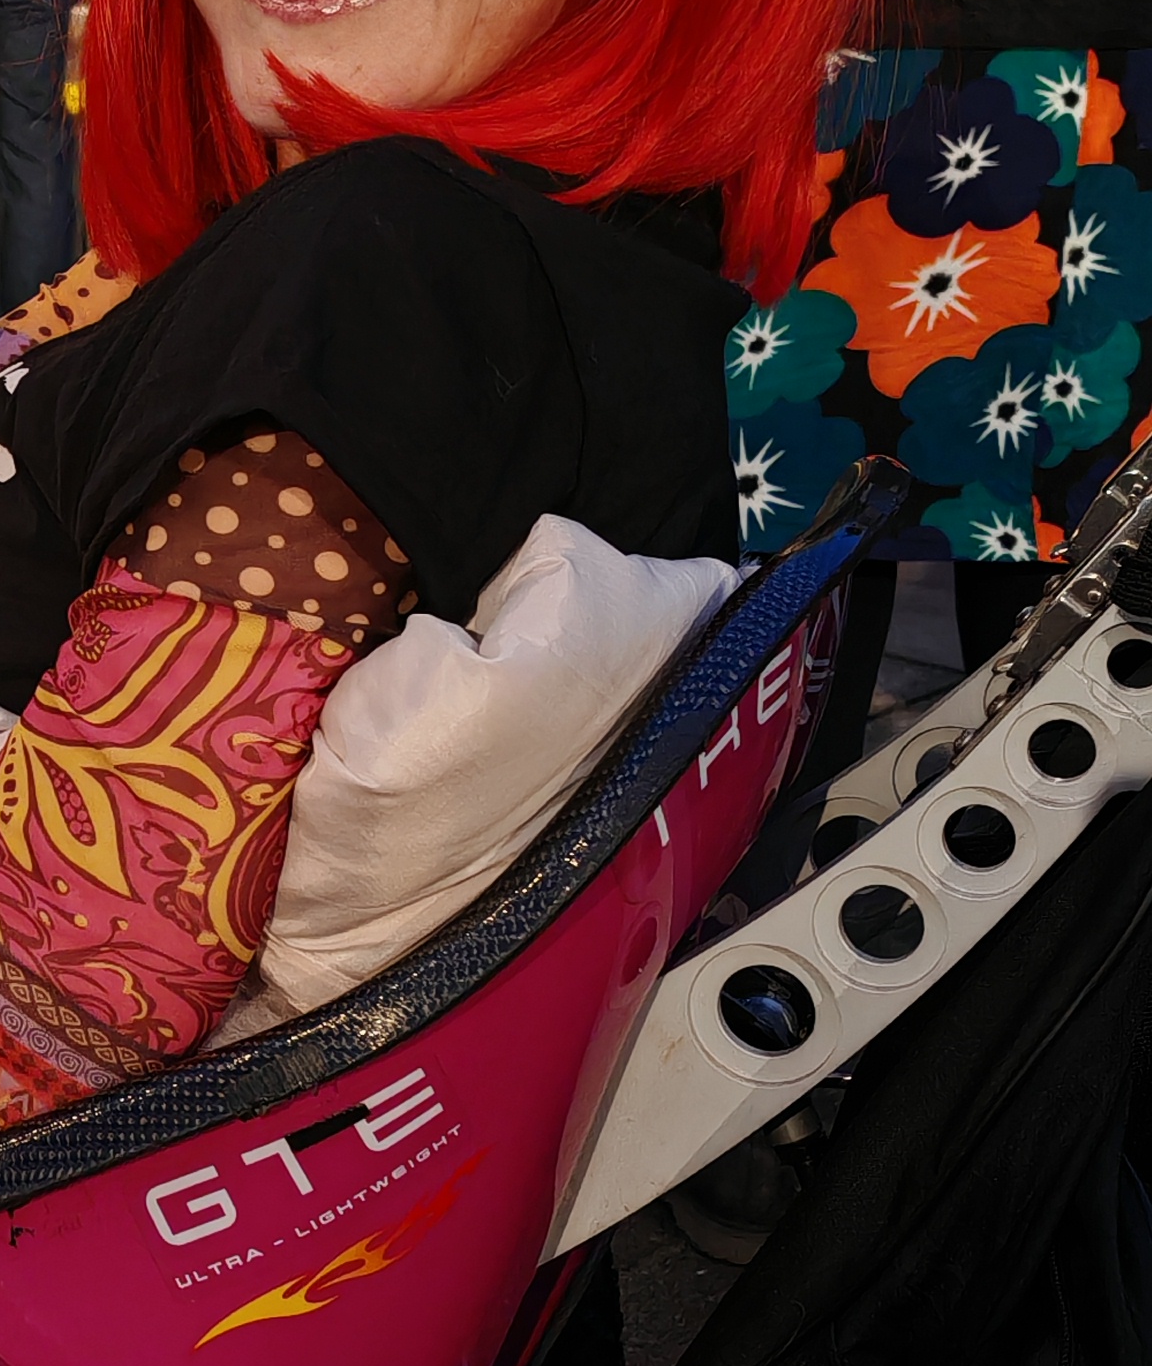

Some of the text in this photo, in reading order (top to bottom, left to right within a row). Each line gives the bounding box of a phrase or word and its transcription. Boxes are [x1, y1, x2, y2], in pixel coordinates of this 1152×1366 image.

[145, 1067, 444, 1246] GTE
[174, 1248, 264, 1289] ULTRA
[294, 1123, 462, 1238] LIGHTWEIGHT
